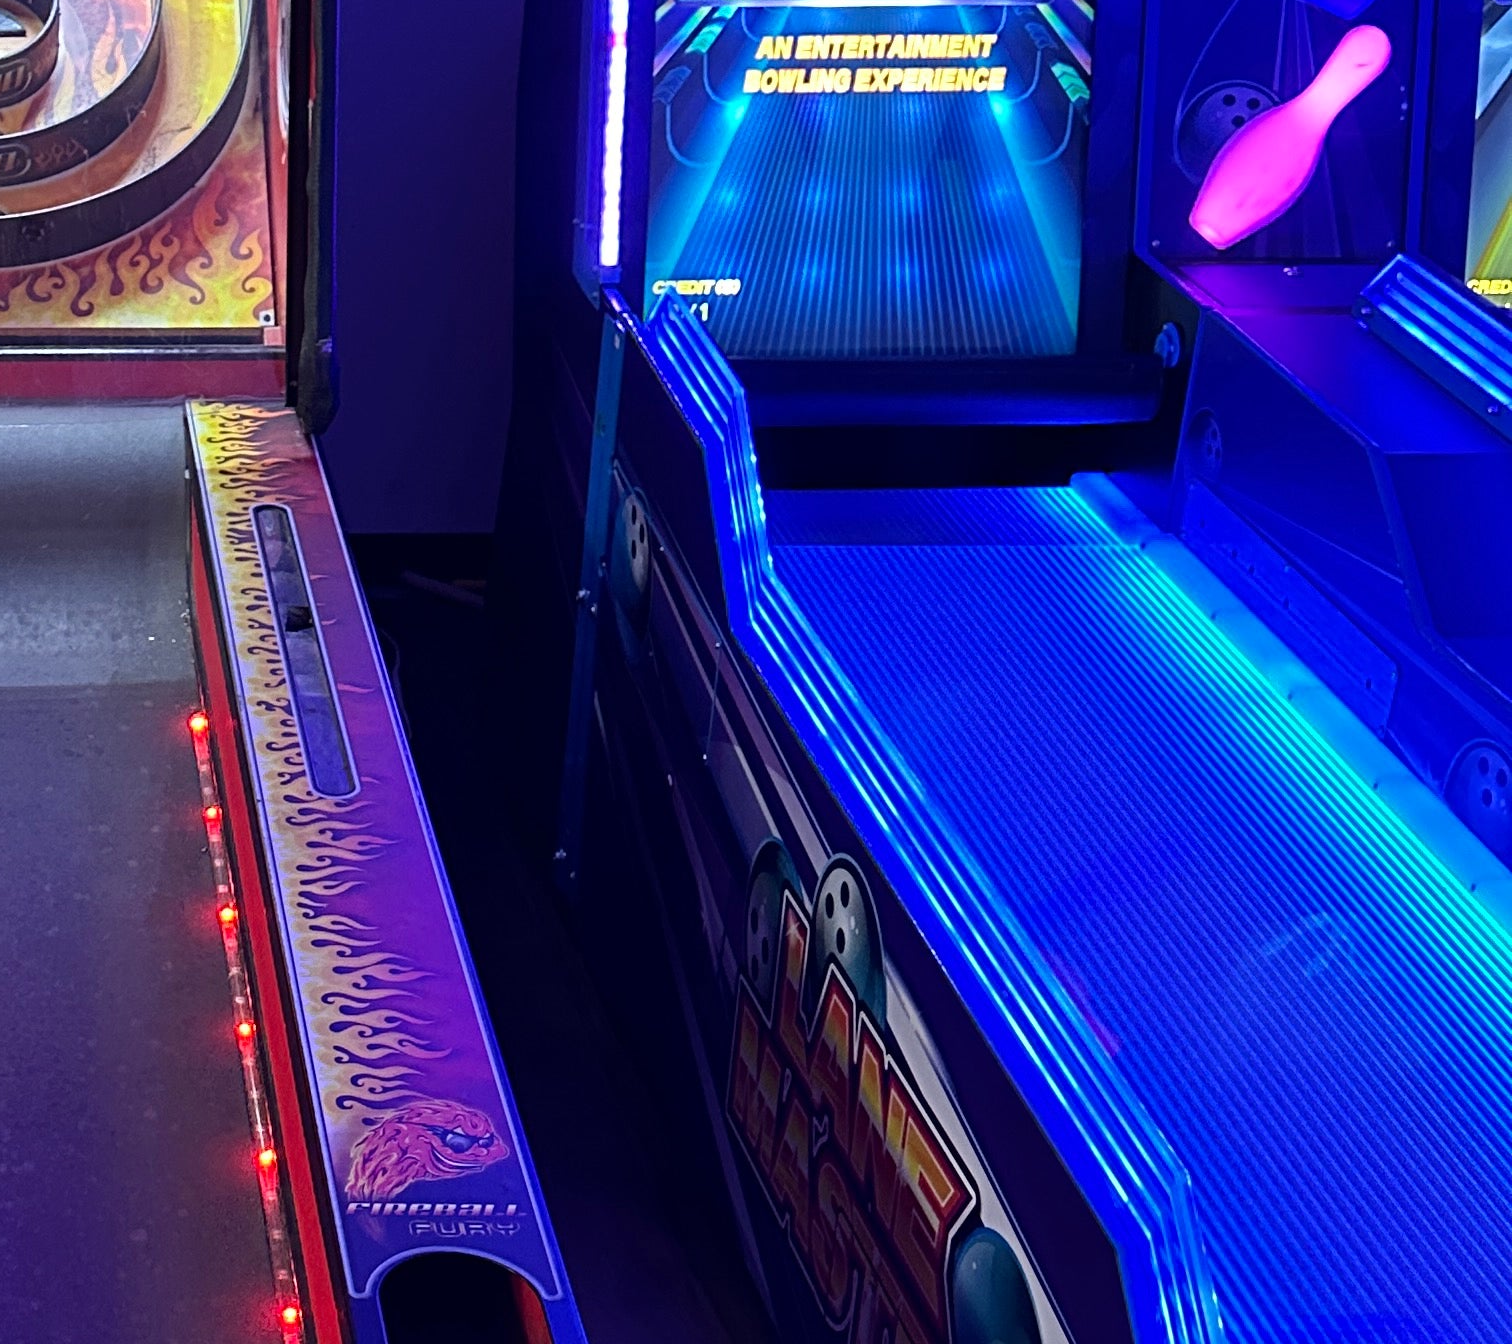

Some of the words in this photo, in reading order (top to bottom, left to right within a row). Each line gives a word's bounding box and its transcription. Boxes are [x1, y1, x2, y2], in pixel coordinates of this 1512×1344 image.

[755, 34, 793, 59] AN
[795, 34, 998, 60] ENTERTAINMENT
[743, 67, 852, 94] BOWLING
[853, 66, 1007, 93] EXPERIENCE
[408, 1220, 520, 1237] FURY
